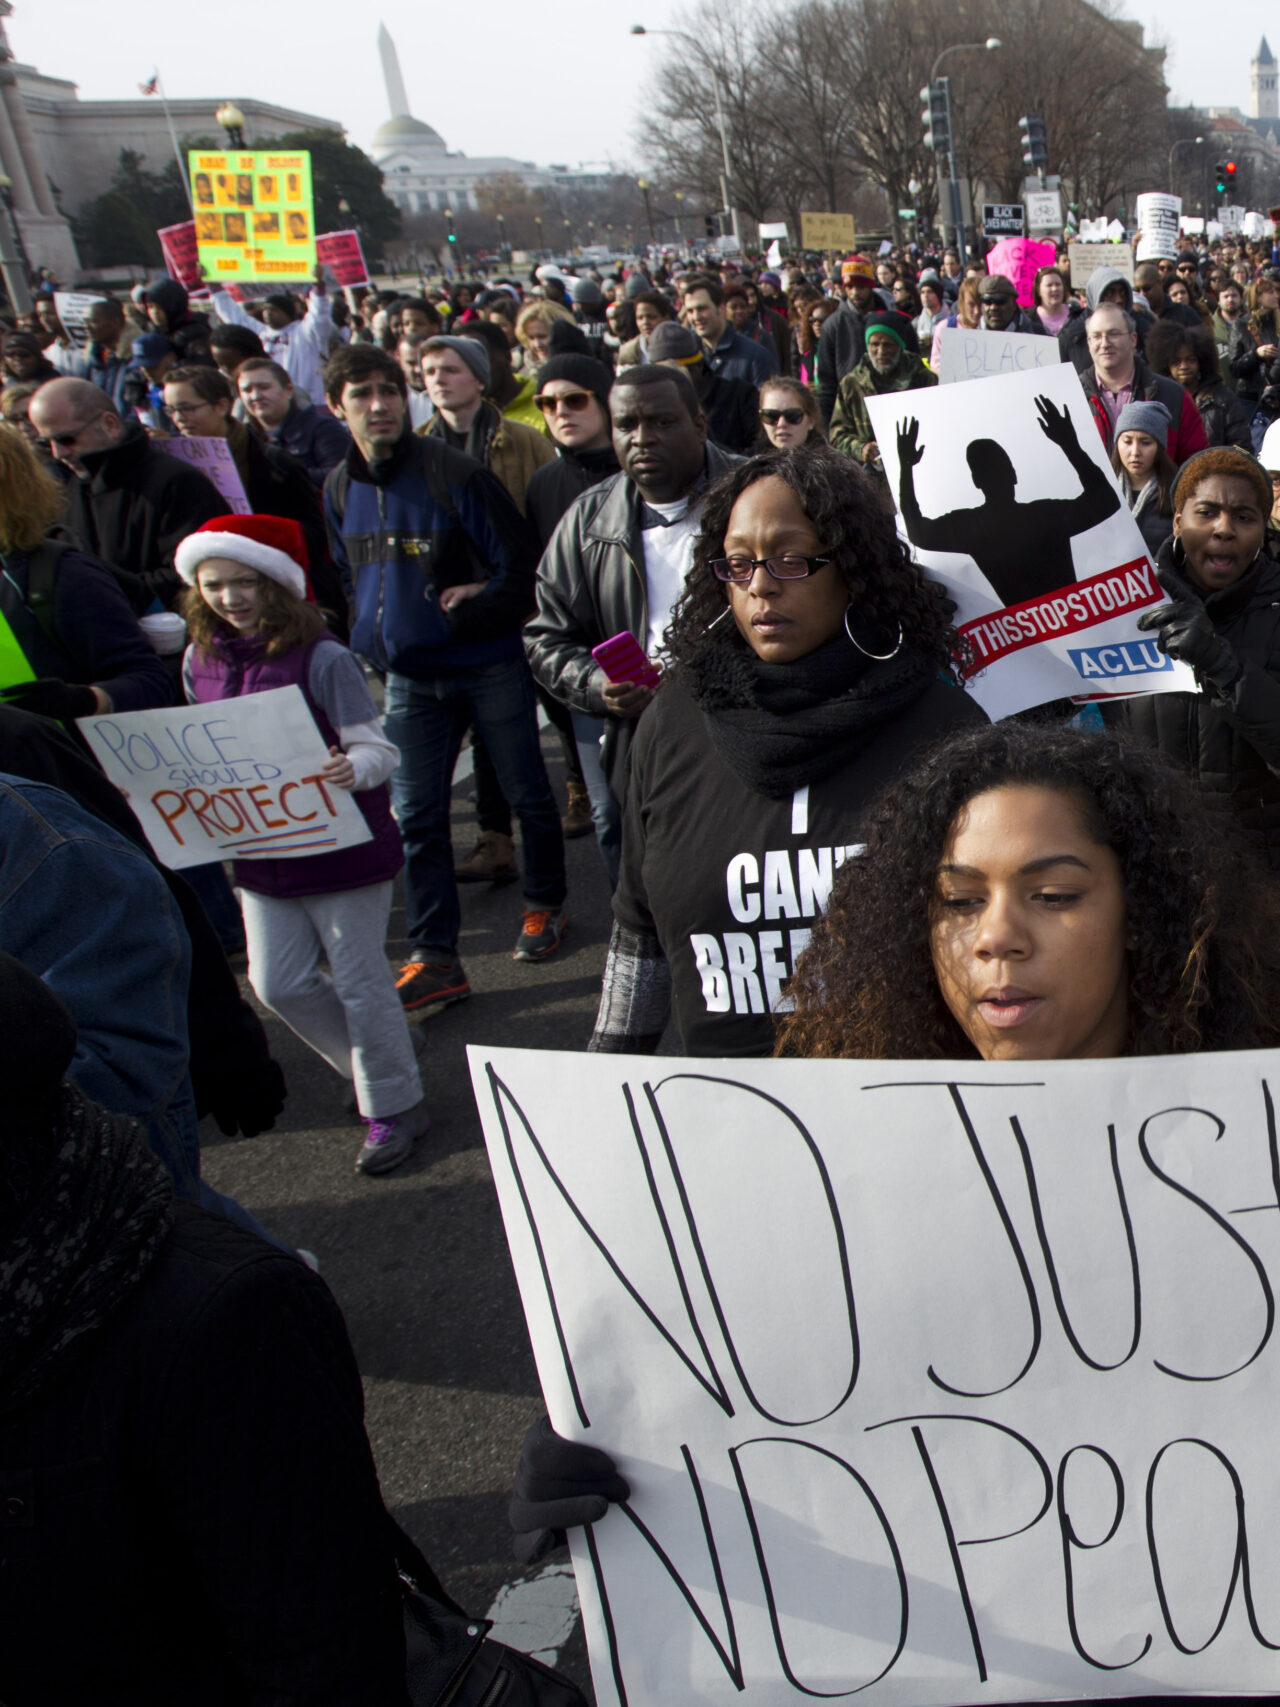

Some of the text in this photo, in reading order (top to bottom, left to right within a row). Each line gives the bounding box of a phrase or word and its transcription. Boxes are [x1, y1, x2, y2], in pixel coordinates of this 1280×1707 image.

[992, 206, 1014, 218] BLACK
[964, 338, 1048, 373] BLACK
[1080, 641, 1167, 676] ACLU
[93, 719, 255, 775] POLICE
[168, 763, 283, 790] SHOULD
[151, 774, 338, 846] PROTECT
[790, 785, 810, 834] I
[726, 843, 869, 924] CAN'
[485, 1061, 861, 1428] NO
[583, 1427, 910, 1707] NO
